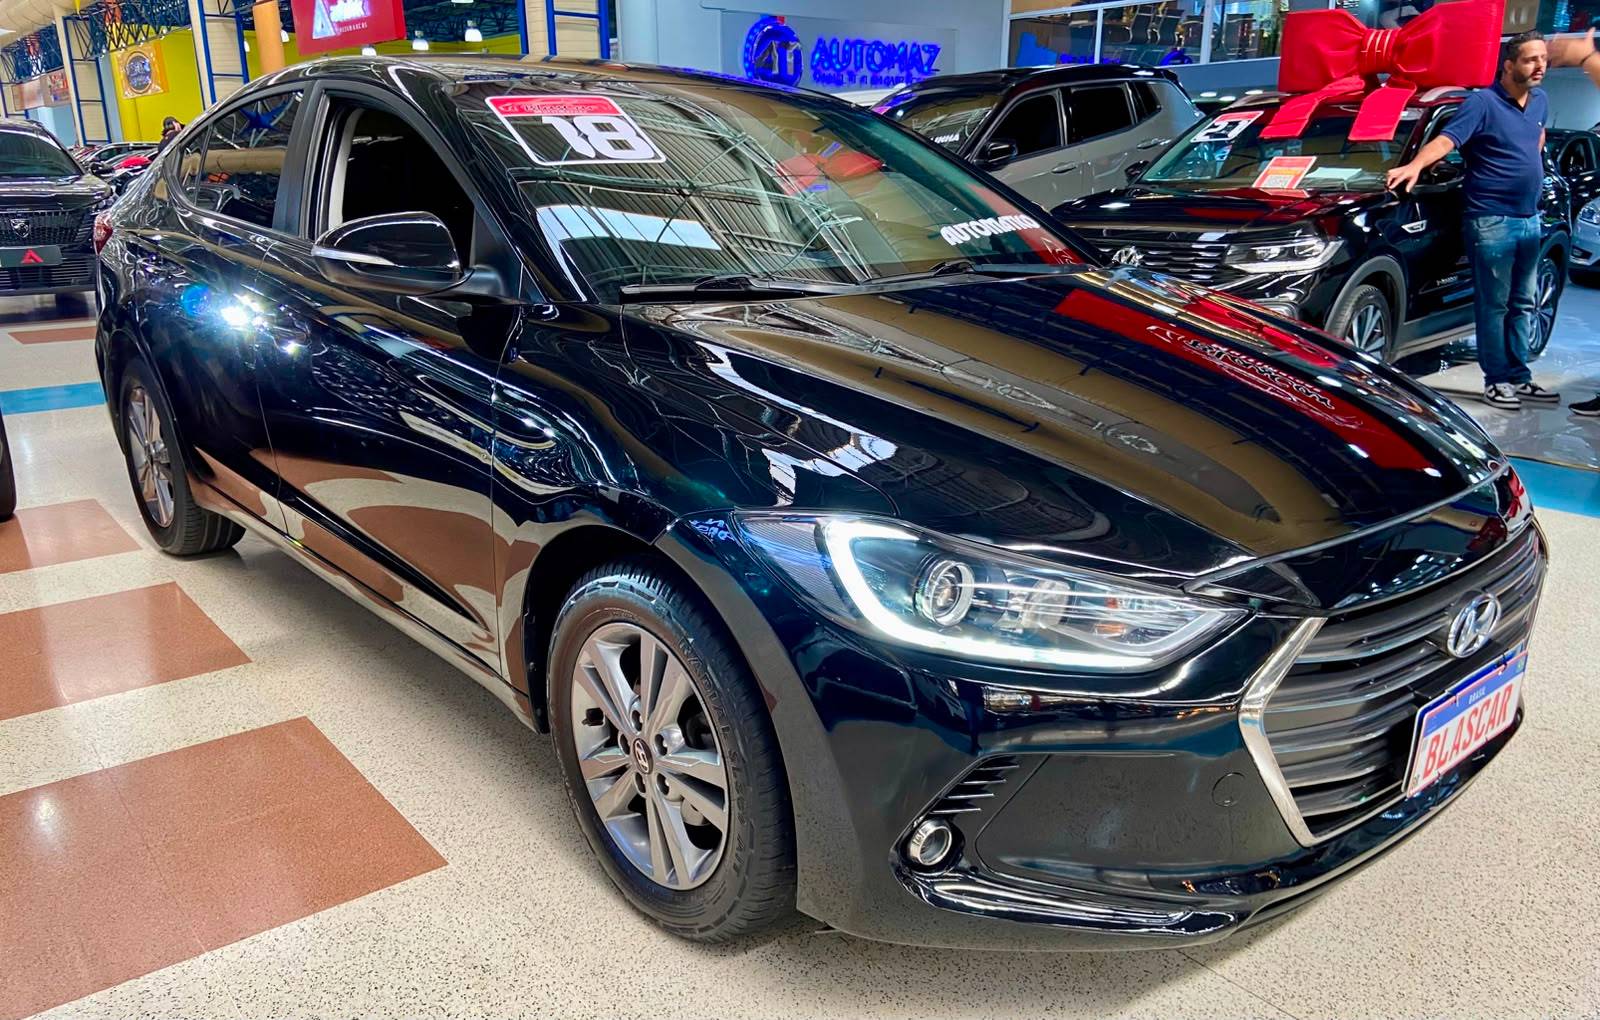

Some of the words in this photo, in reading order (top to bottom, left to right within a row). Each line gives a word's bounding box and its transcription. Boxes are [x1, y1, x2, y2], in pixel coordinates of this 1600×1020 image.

[811, 37, 941, 75] AUTOMAZ
[542, 116, 655, 160] 18
[679, 635, 731, 737] RADIAL
[1422, 684, 1513, 779] BLASCAR
